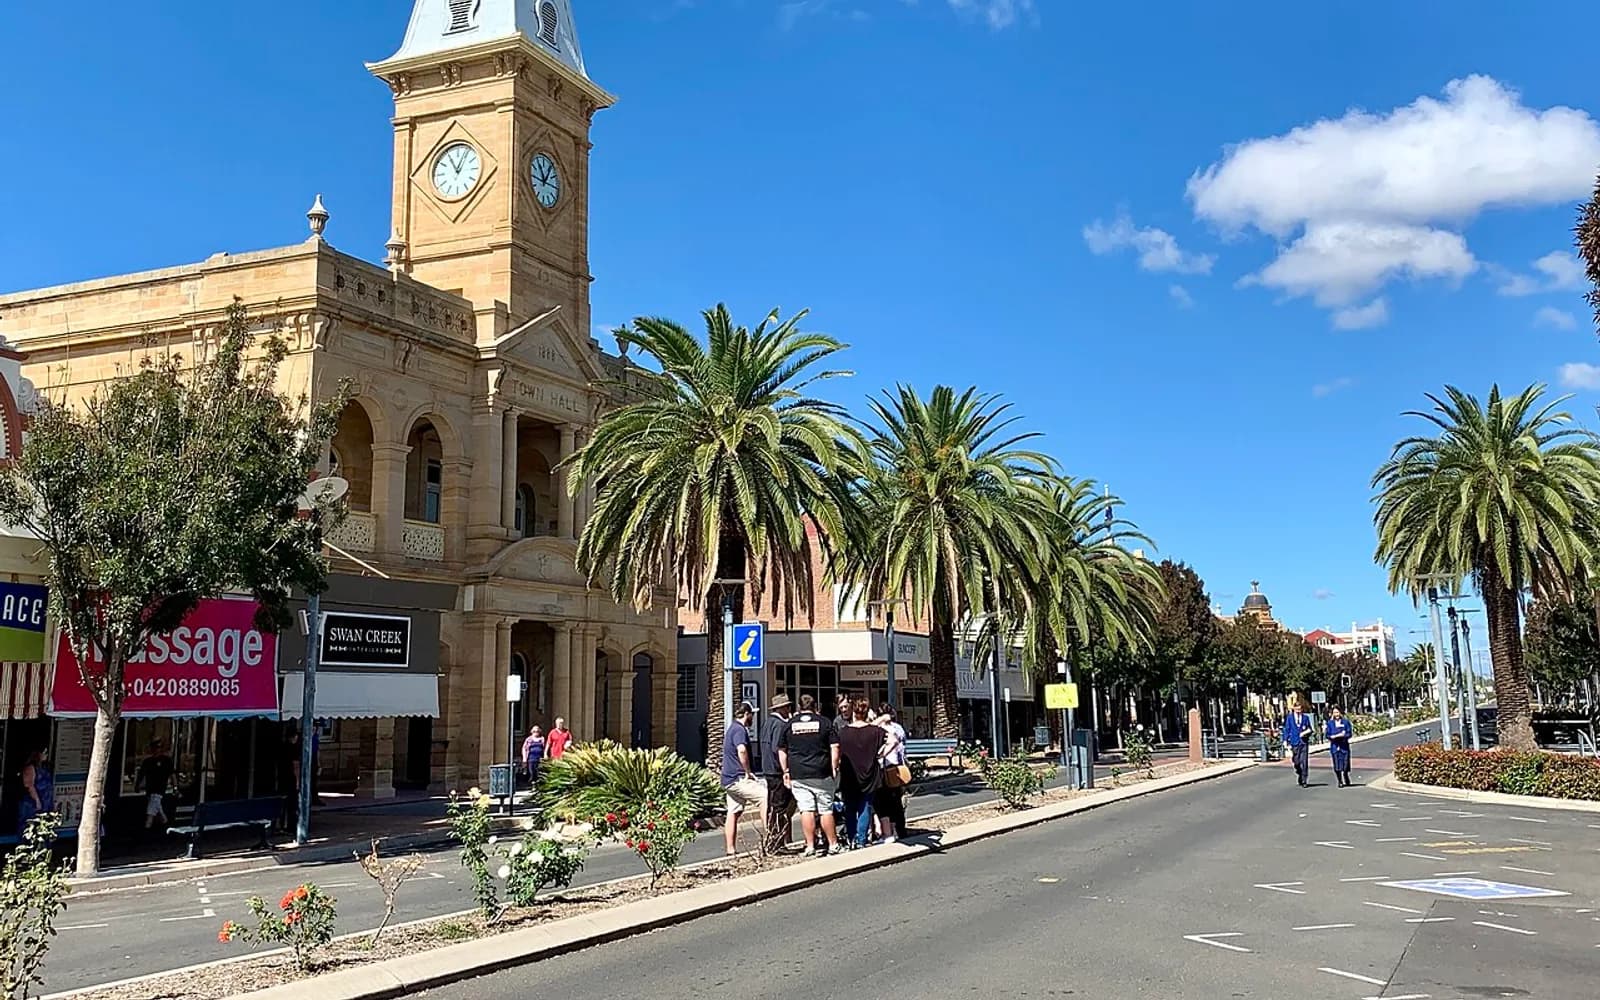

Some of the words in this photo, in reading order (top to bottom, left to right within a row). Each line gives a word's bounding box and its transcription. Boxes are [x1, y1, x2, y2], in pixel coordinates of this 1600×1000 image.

[511, 379, 544, 401] TOWN
[550, 391, 580, 413] HALL
[2, 594, 43, 625] ACE
[92, 616, 264, 678] ssage
[329, 627, 363, 642] SWAN
[365, 629, 402, 645] CREEK
